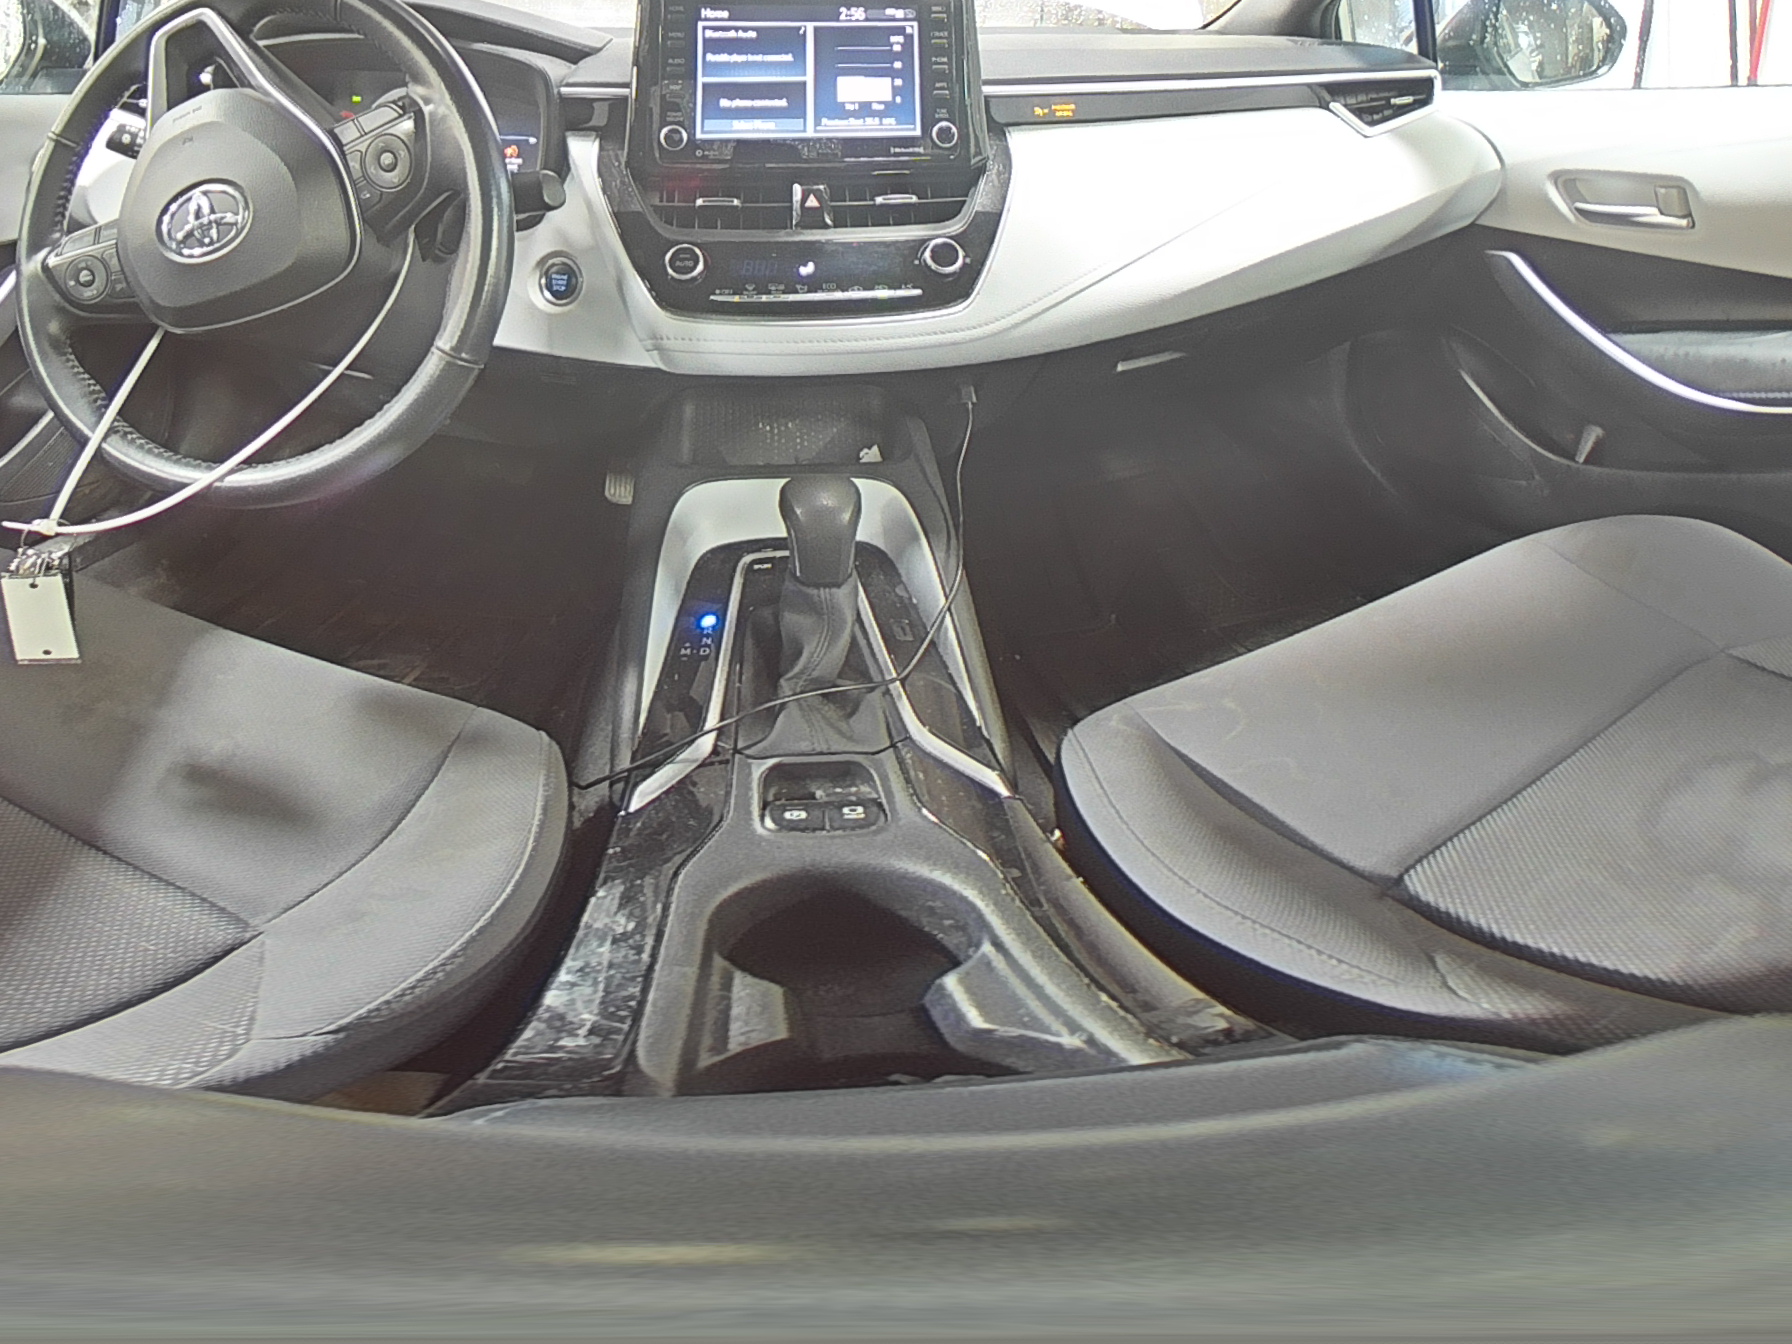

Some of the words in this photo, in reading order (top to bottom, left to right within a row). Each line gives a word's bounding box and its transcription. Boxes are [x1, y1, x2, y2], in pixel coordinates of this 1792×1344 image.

[701, 7, 730, 20] Home
[839, 7, 866, 21] 2:56
[701, 637, 713, 645] N
[680, 647, 692, 655] M
[699, 647, 711, 655] D
